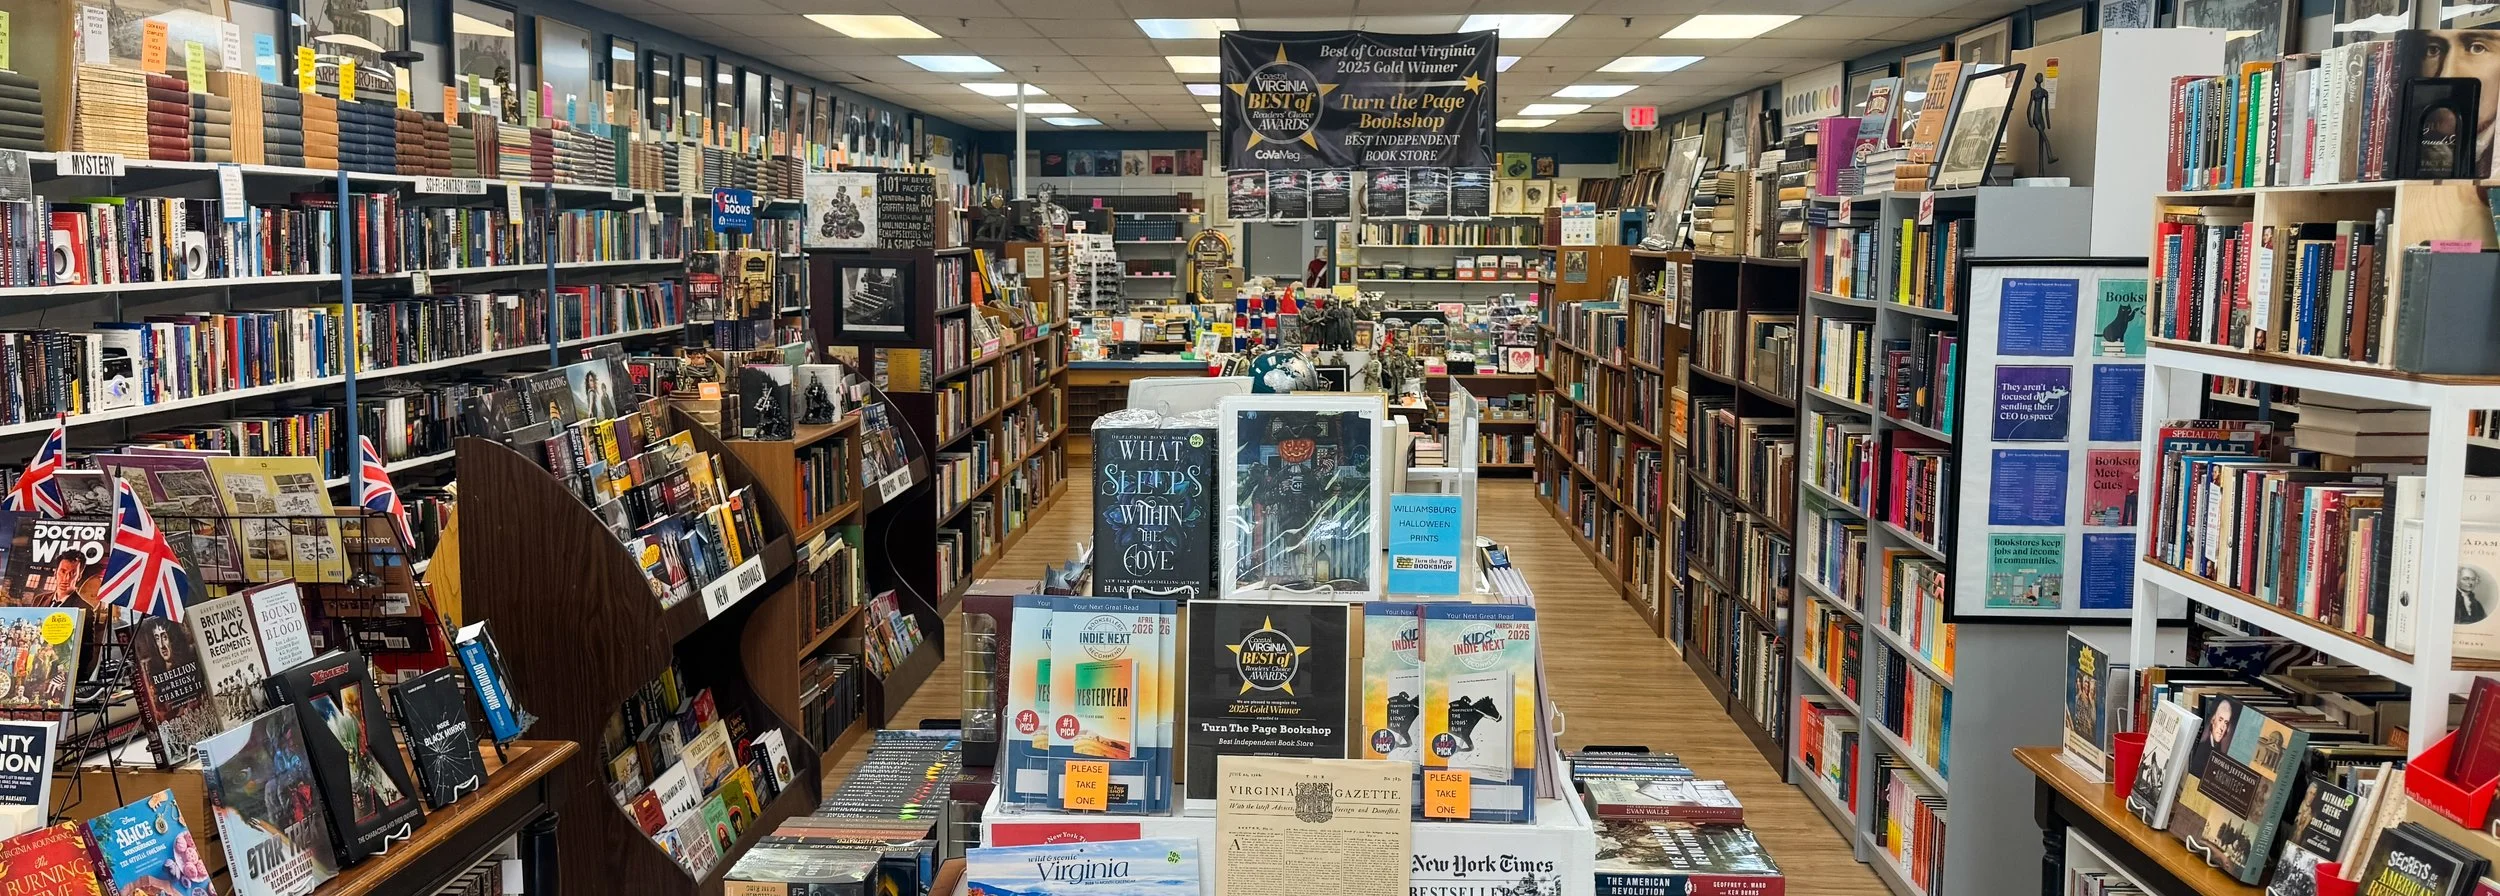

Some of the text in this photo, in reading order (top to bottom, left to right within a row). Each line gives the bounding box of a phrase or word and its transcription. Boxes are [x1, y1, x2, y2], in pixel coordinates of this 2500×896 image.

[1320, 44, 1476, 60] Best of Coastal Virginia
[1337, 61, 1458, 73] 2025 Gold Winner
[1255, 79, 1308, 92] VIRGINIA
[1931, 72, 1950, 91] THE
[1248, 92, 1316, 113] BEST of
[1340, 94, 1465, 113] Turn the Page
[1924, 92, 1947, 111] HALL
[1258, 119, 1310, 131] AWARDS
[1359, 113, 1445, 132] Bookshop
[2268, 81, 2280, 166] JOHN ADAMS
[1345, 134, 1460, 146] BEST INDEPENDENT
[1366, 151, 1437, 161] BOOK STORE
[72, 155, 114, 175] MYSTERY
[883, 177, 899, 192] 101
[724, 204, 750, 216] BOOKS
[882, 203, 920, 212] GRIFFITH PARK
[2347, 270, 2356, 315] WASHINGTON
[530, 375, 567, 394] NOW PLAYING
[2002, 383, 2046, 392] They aren't
[2001, 392, 2032, 401] focused
[2000, 403, 2054, 412] sending their
[2000, 412, 2018, 420] CEO
[2030, 414, 2053, 422] space
[2172, 430, 2206, 438] SPECIAL
[1119, 440, 1184, 462] WHAT
[1102, 464, 1202, 498] SLEEPS
[2094, 480, 2122, 490] Cutes
[1120, 500, 1184, 526] WITHIN
[1394, 506, 1456, 514] WILLIAMSBURG
[1400, 520, 1450, 528] HALLOWEEN
[34, 525, 106, 540] DOCTOR
[1138, 528, 1162, 542] THE
[1410, 534, 1438, 542] PRINTS
[1994, 538, 2060, 550] Bookstores keep
[2306, 508, 2318, 572] American Revolution
[32, 540, 104, 565] WHO
[1994, 548, 2059, 558] jobs and income
[1124, 544, 1174, 577] COVE
[1994, 556, 2058, 566] in communities.
[714, 564, 762, 608] NEW ARRIVALS
[200, 606, 243, 629] BRITAIN'S
[261, 602, 298, 622] BOUND
[1447, 612, 1461, 620] Your
[1138, 616, 1154, 624] APRIL
[205, 618, 248, 646] BLACK
[266, 620, 302, 641] BLOOD
[1132, 624, 1154, 634] 2026
[1508, 630, 1530, 640] 2026
[1080, 632, 1132, 644] INDIE NEXT
[210, 636, 251, 658] REGIMENTS
[1248, 642, 1288, 652] VIRGINIA
[1454, 639, 1505, 656] INDIE NEXT
[1242, 652, 1274, 664] BEST
[152, 662, 197, 685] REBELLION
[1249, 672, 1288, 680] AWARDS
[171, 674, 192, 688] REIGN
[158, 685, 194, 703] CHARLES
[1077, 688, 1128, 707] YESTERYEAR
[1228, 704, 1301, 714] 2025 Gold Winner
[436, 720, 450, 730] INSIDE
[1060, 728, 1076, 736] PICK
[1202, 724, 1332, 736] Turn The Page Bookshop
[424, 720, 467, 748] BLACK MIRROR
[1218, 738, 1234, 746] Best
[1234, 738, 1276, 747] Independent
[1436, 748, 1452, 756] PICK
[1071, 765, 1103, 774] PLEASE
[2211, 755, 2256, 786] THOMAS JEFFERSON
[1076, 780, 1096, 790] TAKE
[1430, 774, 1462, 782] PLEASE
[2216, 770, 2243, 794] ARCHITECT
[1230, 786, 1401, 800] VIRGINIA GAZETTE.
[1436, 790, 1456, 798] TAKE
[1076, 796, 1096, 805] ONE
[1436, 806, 1456, 814] ONE
[1646, 808, 1669, 816] WALLS
[2322, 804, 2341, 820] GREENE
[119, 816, 136, 825] Disney
[2310, 817, 2342, 836] SOUTH CAROLINA
[115, 820, 154, 849] ALICE
[2256, 822, 2274, 857] ARCHITECT
[0, 830, 72, 860] VIRGINIA ROUNDING
[123, 838, 157, 856] WONDERLAND
[246, 812, 317, 880] STAR TREK
[34, 856, 48, 869] The
[1412, 854, 1554, 878] New York Times
[6, 857, 88, 896] BURNING
[1037, 857, 1128, 884] Virginia
[2388, 850, 2438, 890] SECRETS OF THE
[1607, 877, 1670, 887] THE AMERICAN
[2379, 867, 2437, 896] AMERICAN
[1612, 887, 1665, 896] REVOLUTION
